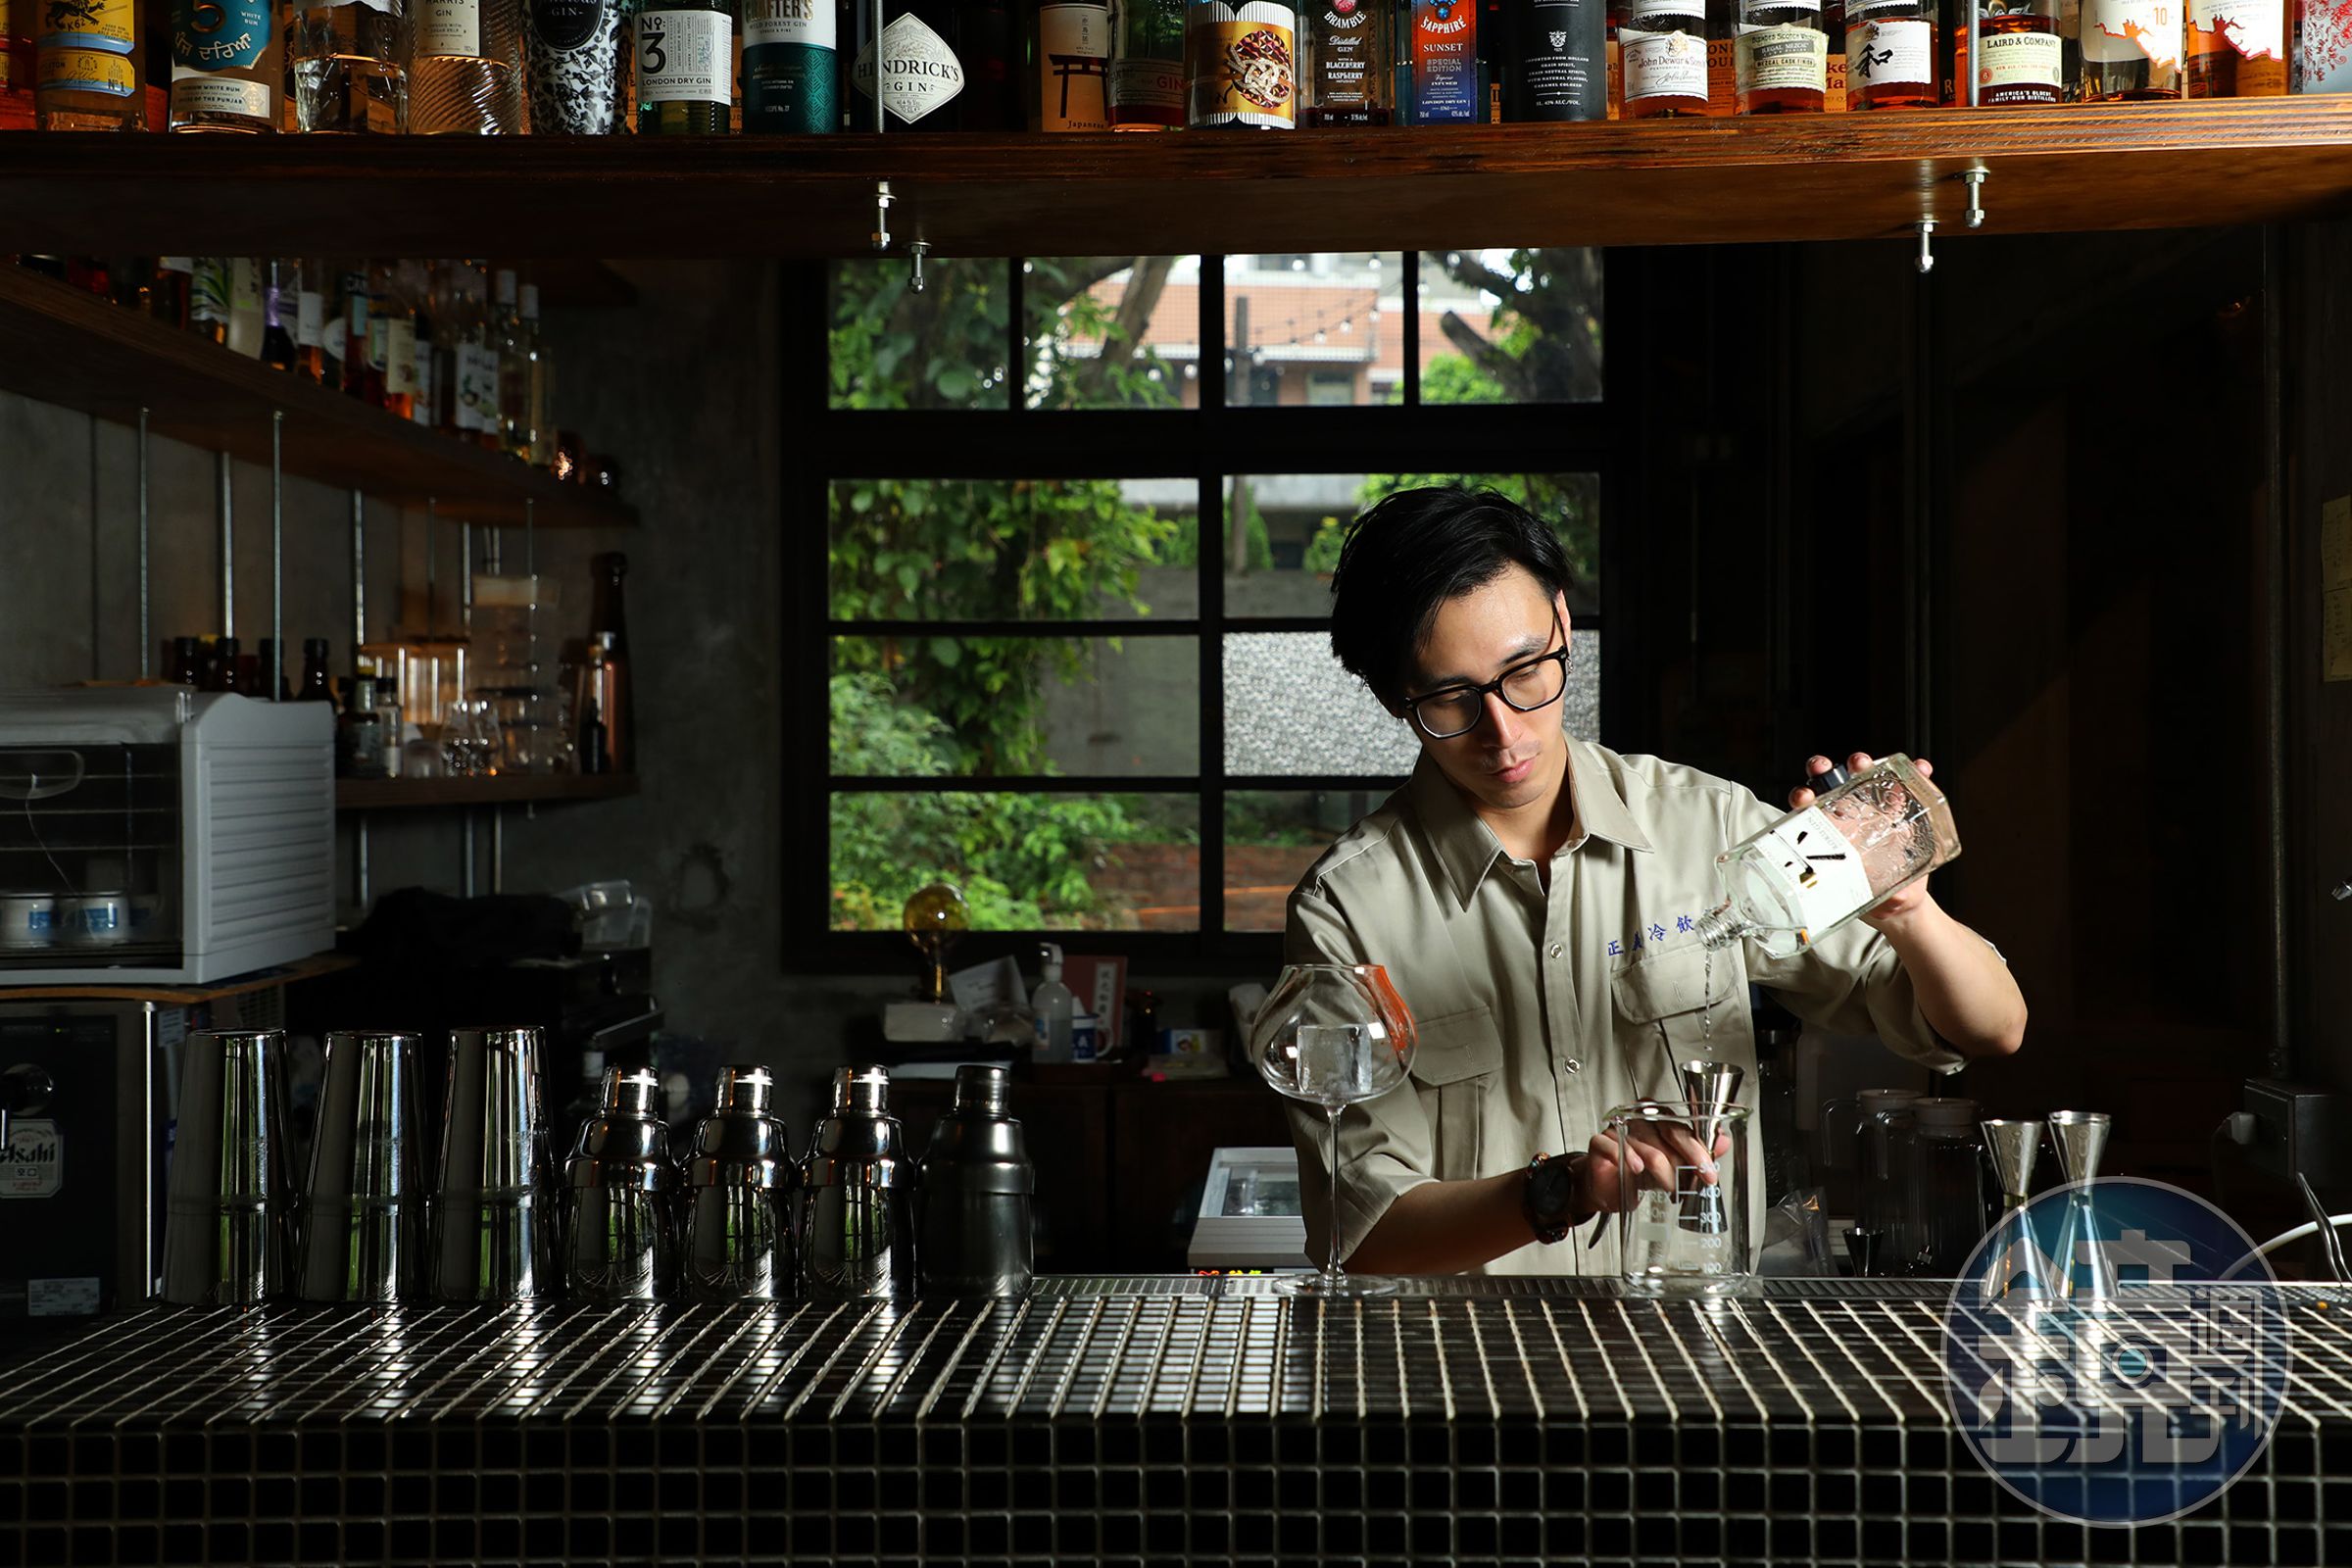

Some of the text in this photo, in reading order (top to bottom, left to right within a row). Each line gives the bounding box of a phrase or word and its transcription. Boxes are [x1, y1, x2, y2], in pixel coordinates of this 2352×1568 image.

[240, 11, 262, 20] WHITE
[551, 7, 577, 16] GIN
[2152, 7, 2168, 25] 10
[67, 19, 86, 31] K62
[1324, 11, 1367, 28] BRAMBLE
[1420, 15, 1467, 34] SAPPHIRE
[1423, 43, 1463, 53] SUNSET
[1986, 35, 2056, 49] LAIRD & COMPANY
[641, 32, 666, 74] 3
[1639, 57, 1658, 69] John
[1658, 56, 1684, 66] Dewar
[1854, 43, 1894, 78] 和
[642, 77, 676, 86] LONDON
[894, 81, 927, 92] GIN
[1157, 75, 1184, 90] GIN
[0, 1143, 56, 1163] Asahi
[1637, 1189, 1672, 1203] PYREX
[1698, 1187, 1721, 1199] 400
[1699, 1211, 1722, 1224] 300
[1700, 1238, 1722, 1249] 200
[1703, 1262, 1722, 1274] 100
